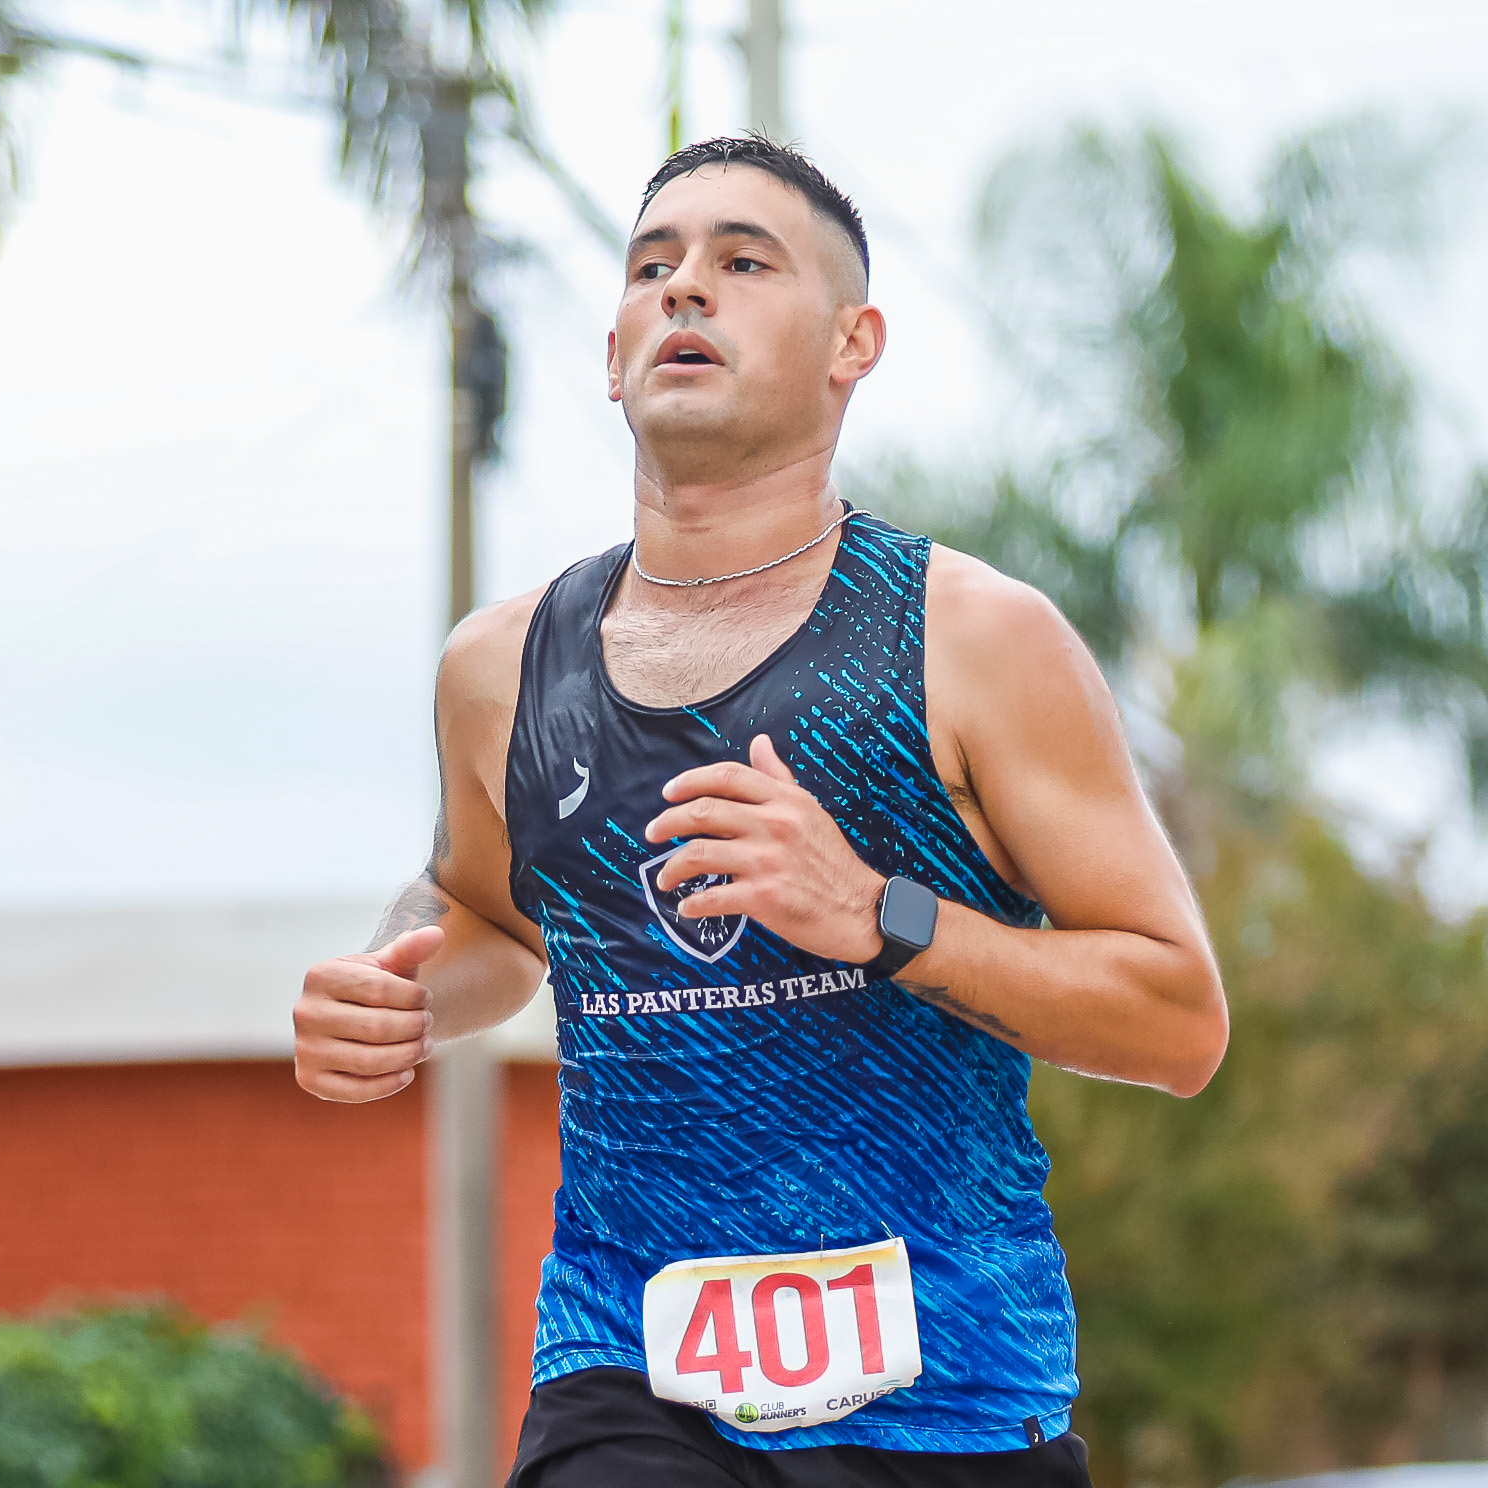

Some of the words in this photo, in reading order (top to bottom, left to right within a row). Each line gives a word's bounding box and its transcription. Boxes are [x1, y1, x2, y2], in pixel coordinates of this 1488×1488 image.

[581, 993, 619, 1015] LAS
[627, 982, 775, 1014] PANTERAS
[780, 968, 867, 1001] TEAM
[675, 1263, 885, 1394] 401
[760, 1401, 785, 1412] CLUB
